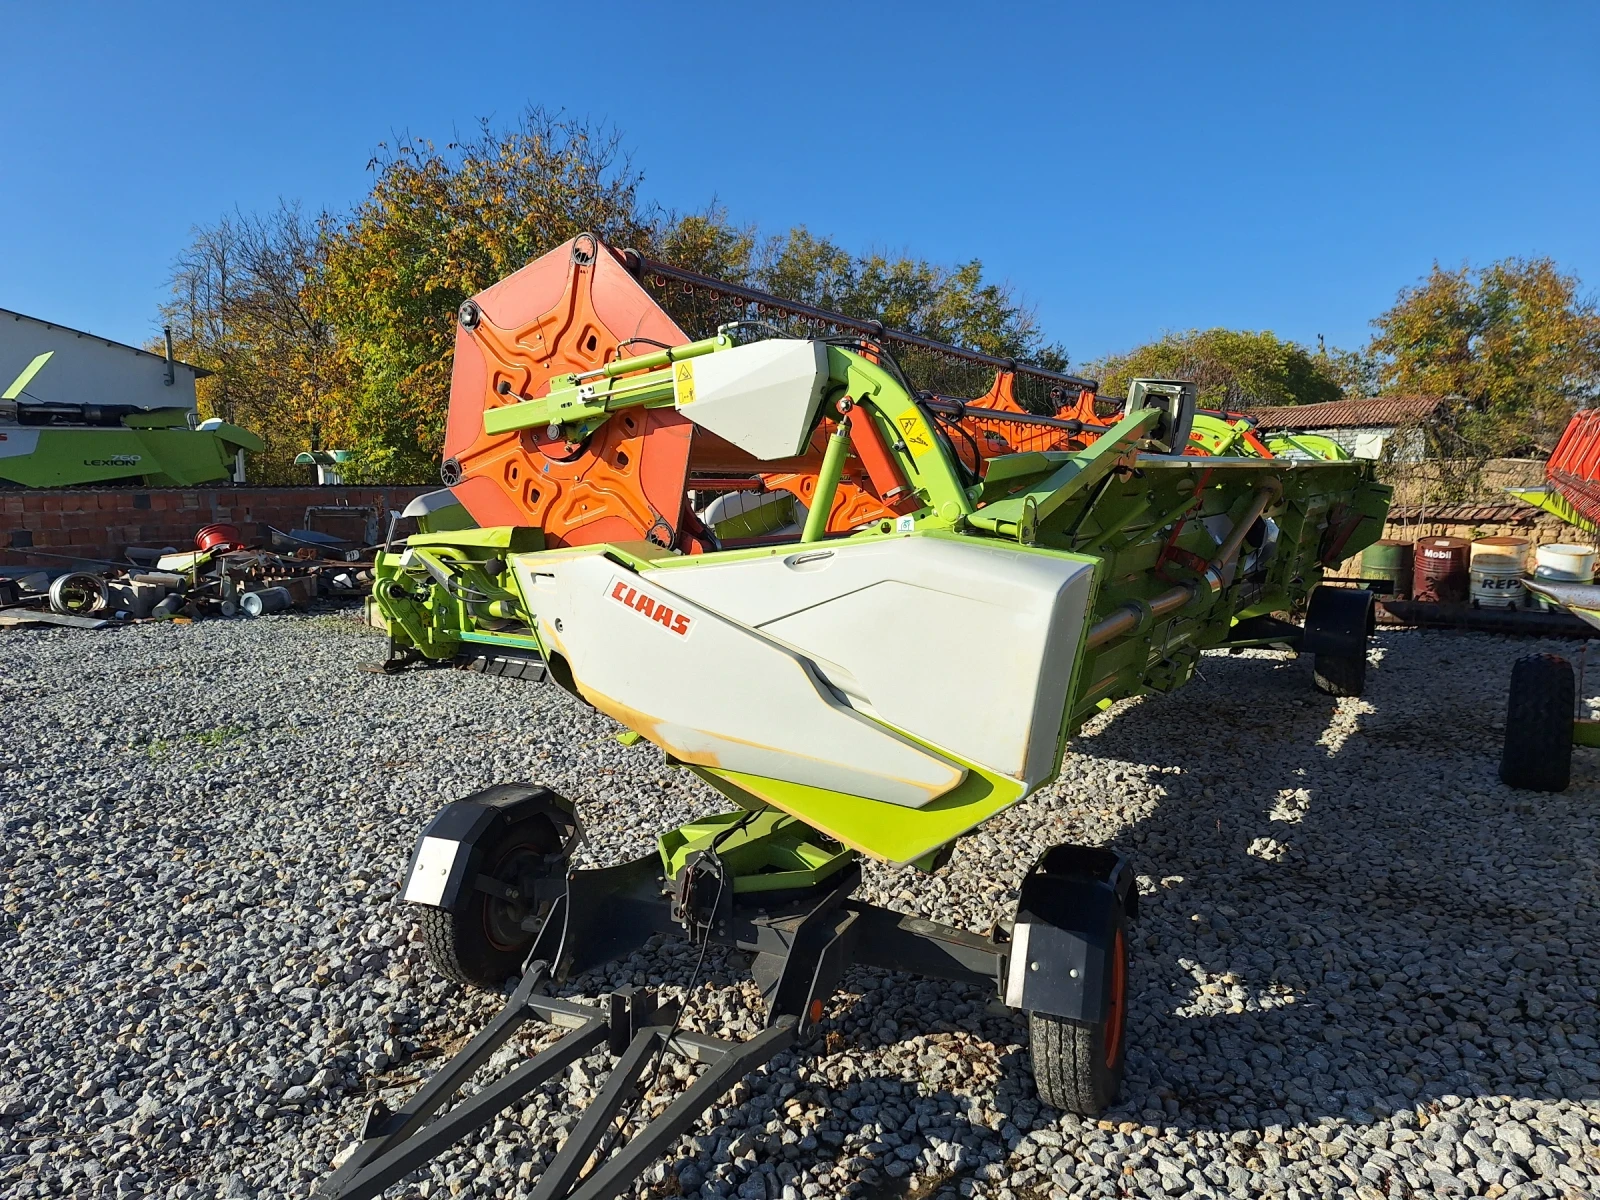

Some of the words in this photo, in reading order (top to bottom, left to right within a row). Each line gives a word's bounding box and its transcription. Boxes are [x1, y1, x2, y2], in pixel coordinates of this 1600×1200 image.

[83, 459, 136, 467] LEXION
[1424, 549, 1452, 559] Mobil
[611, 581, 691, 635] CLAAS
